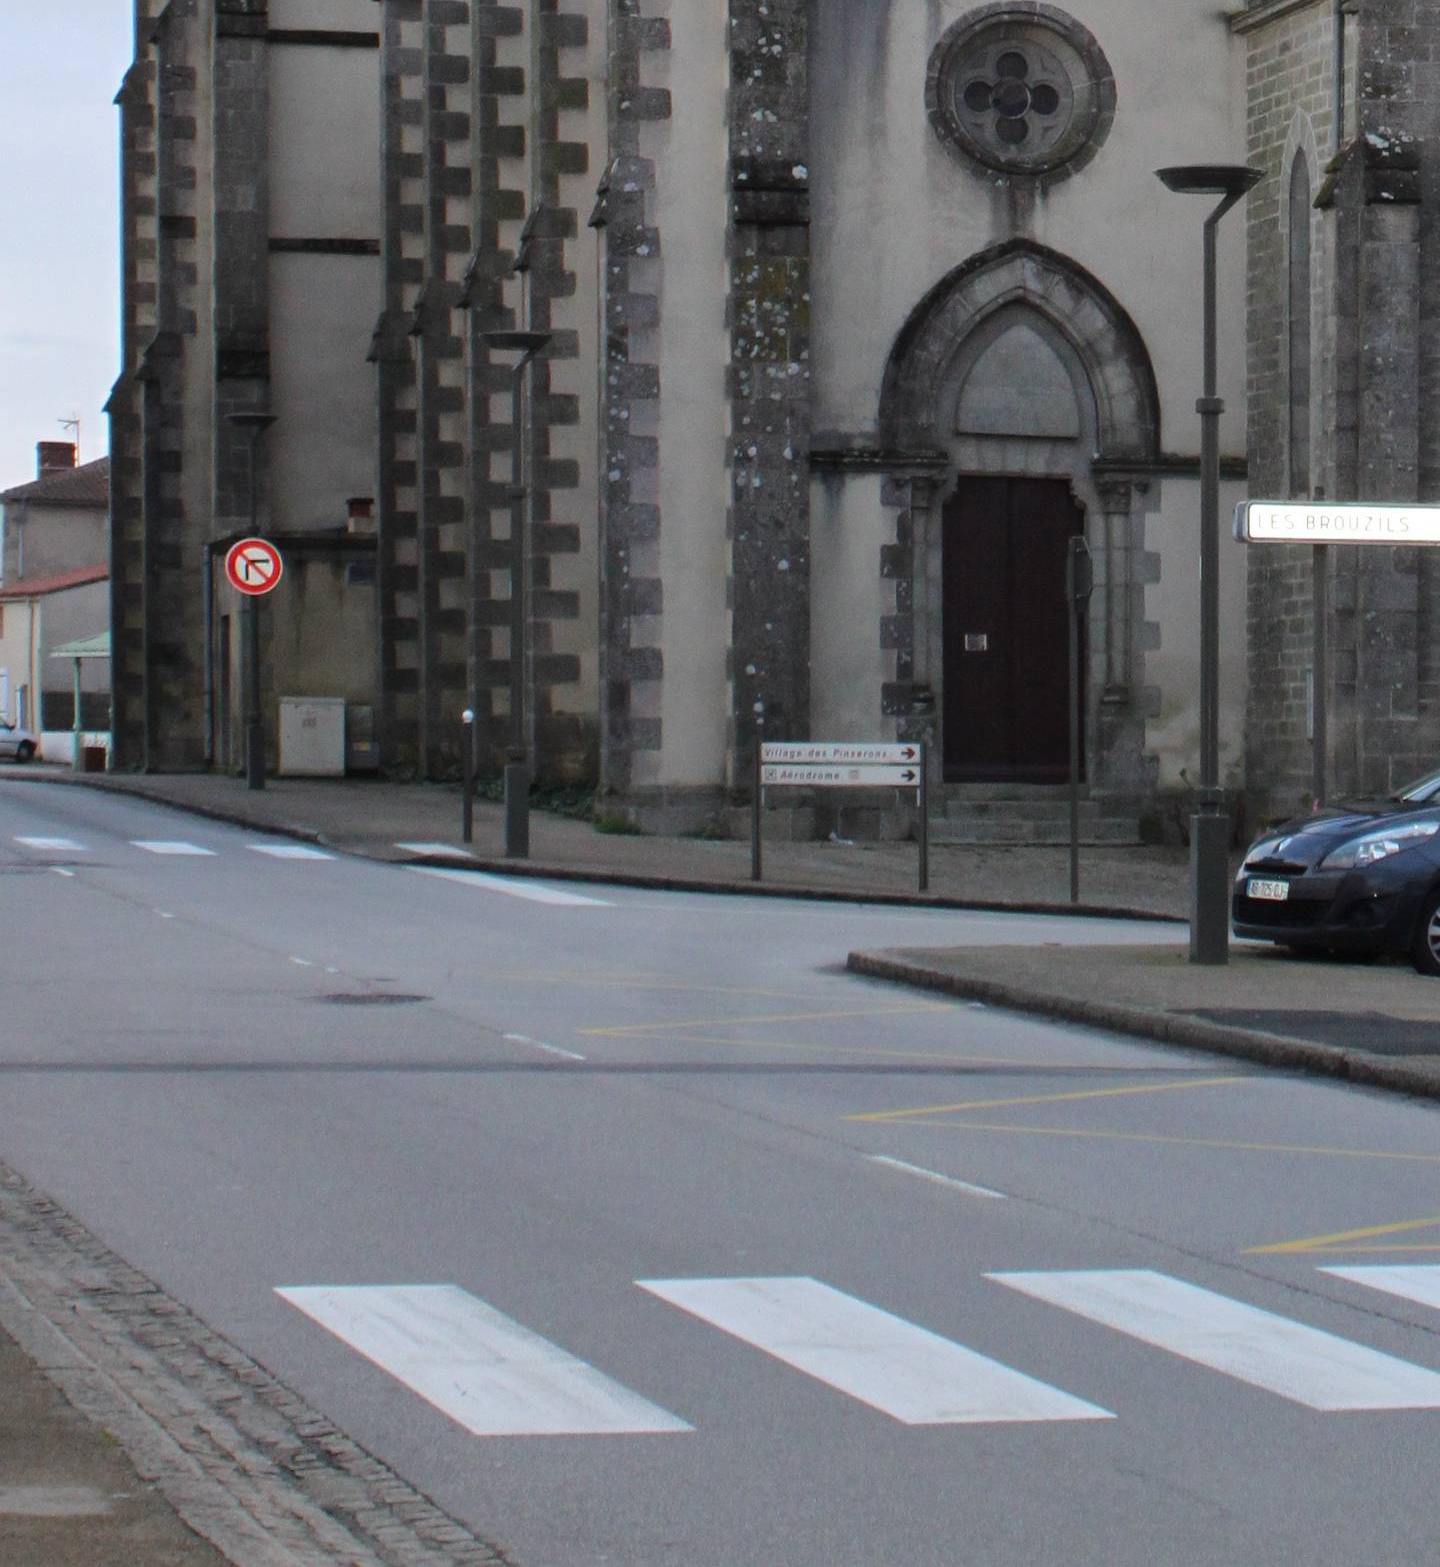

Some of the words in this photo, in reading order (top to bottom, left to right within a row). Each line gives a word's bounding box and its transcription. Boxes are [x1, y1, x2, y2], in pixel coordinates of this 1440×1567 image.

[1258, 514, 1294, 530] LES
[1306, 515, 1410, 533] BROUZILS
[765, 748, 802, 759] Village
[808, 748, 827, 757] des
[780, 769, 840, 780] Aérodrome
